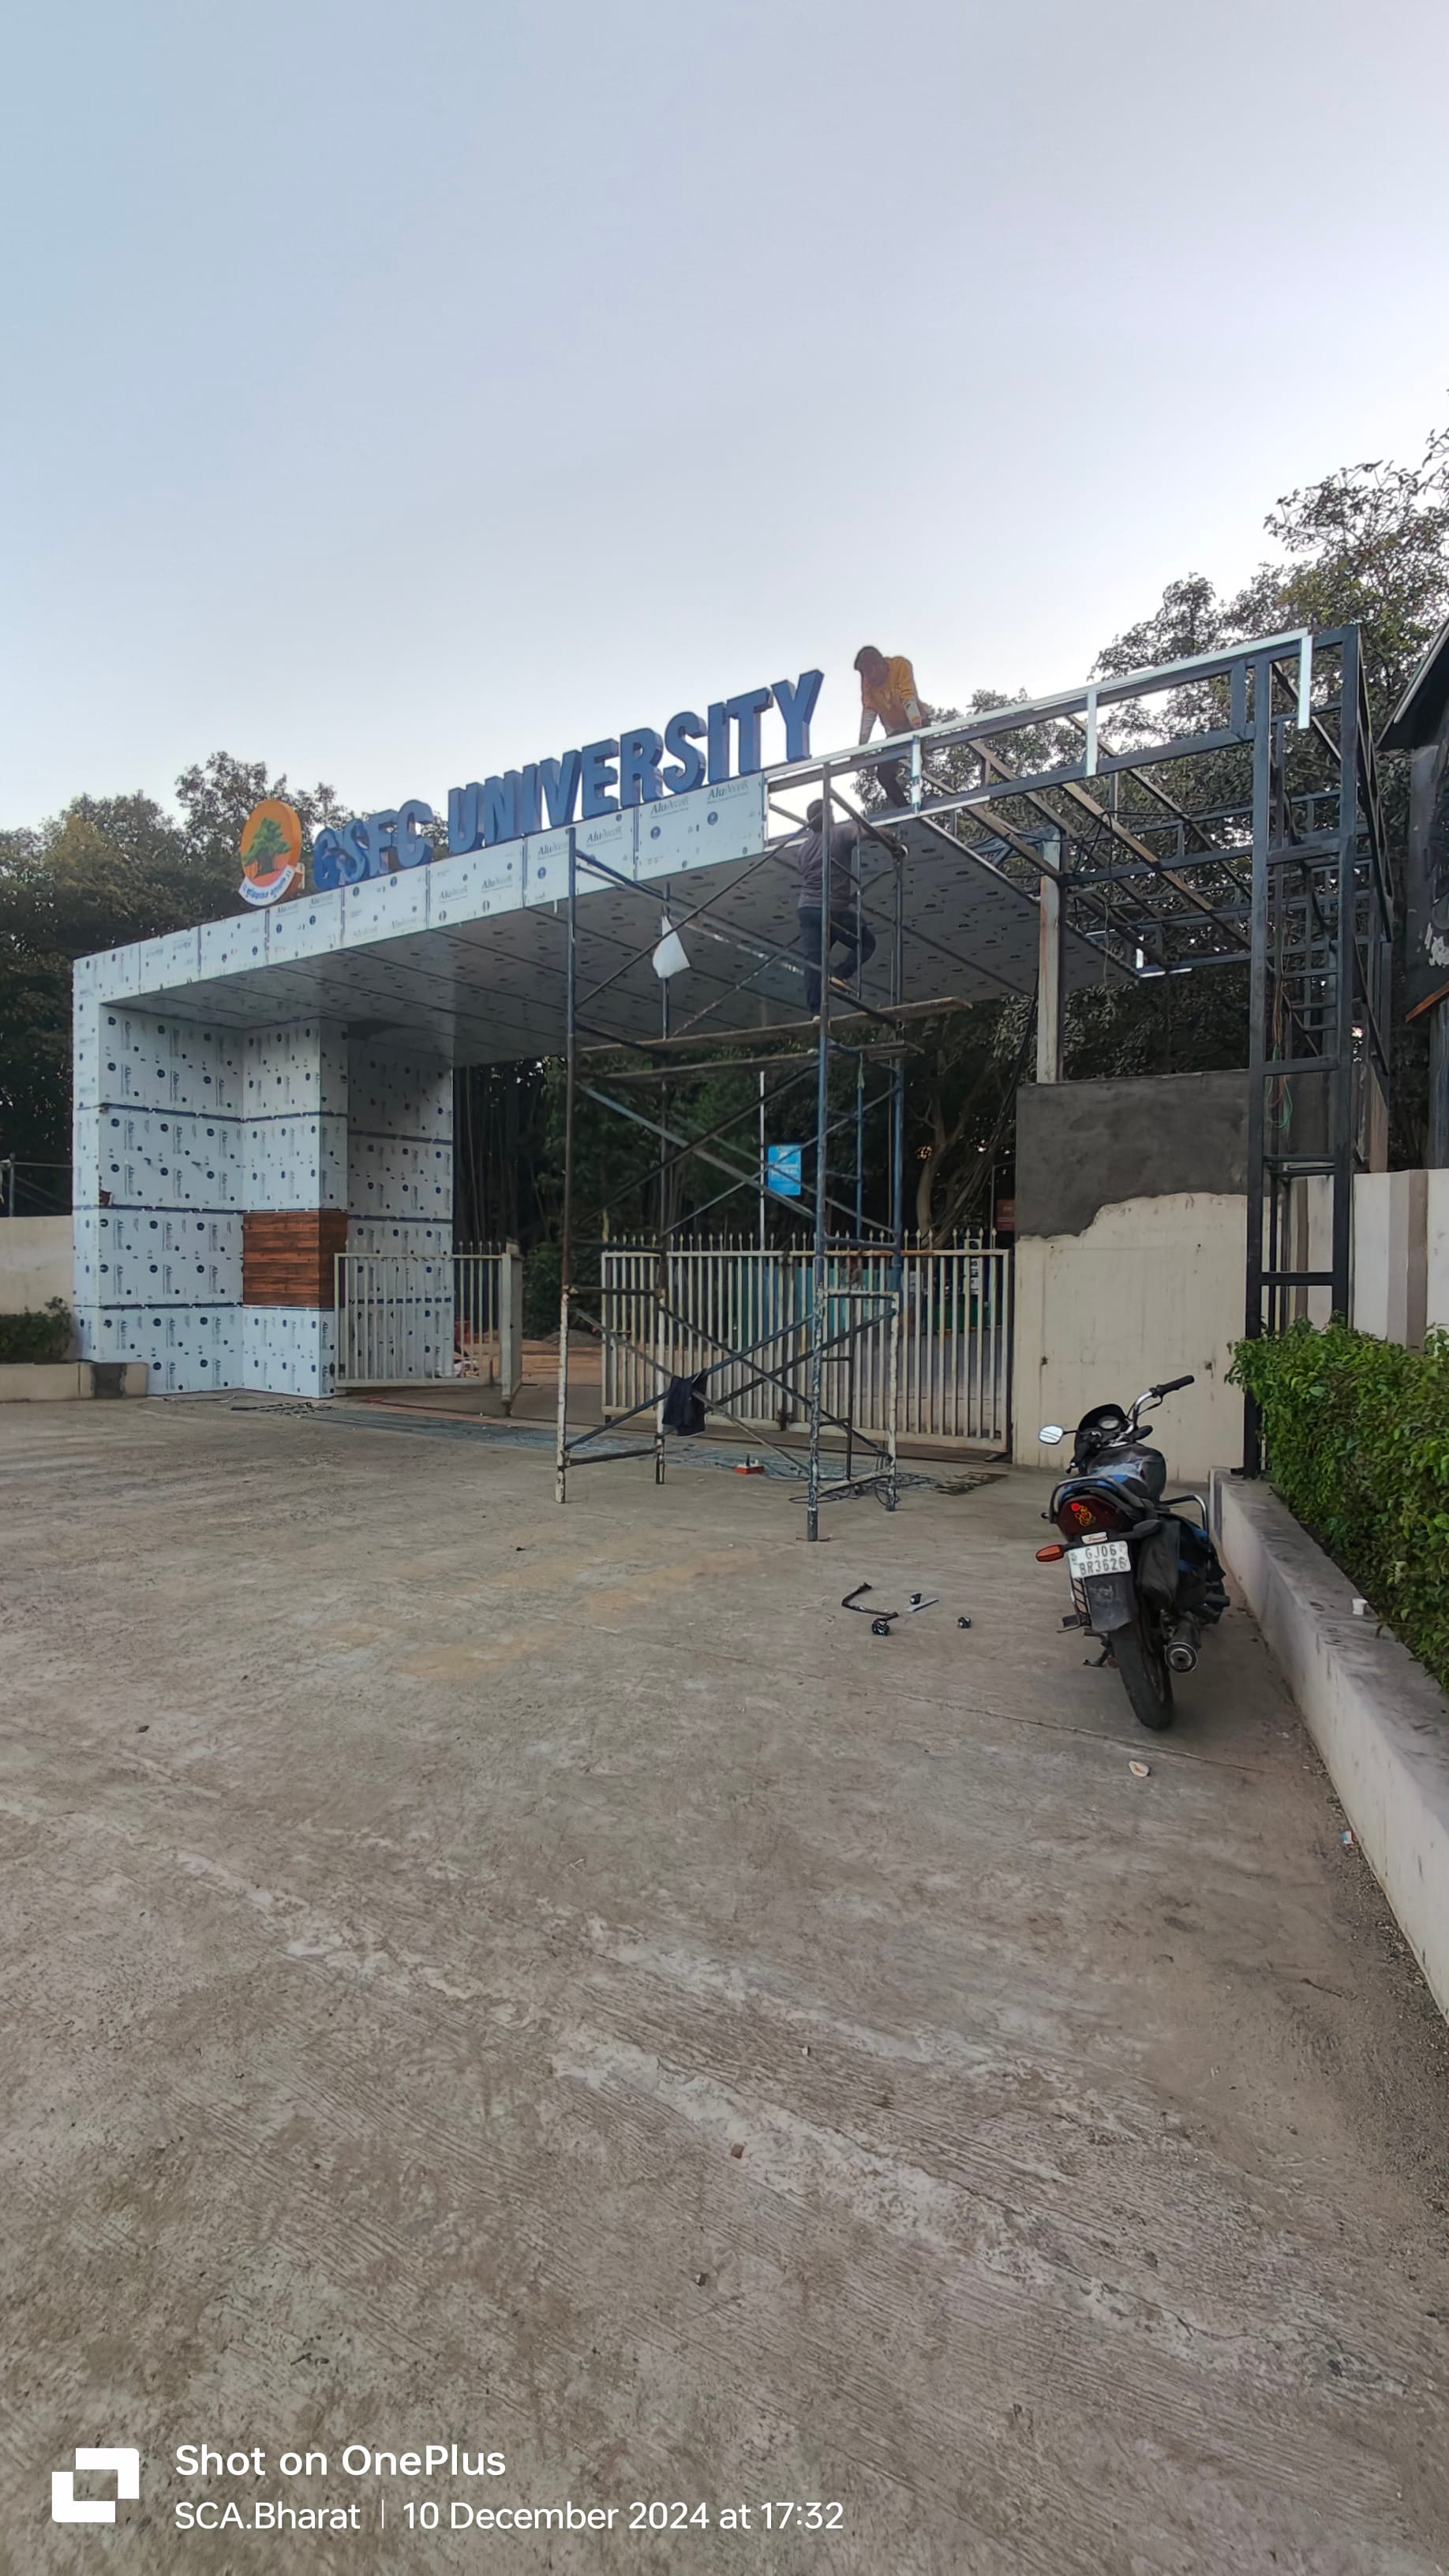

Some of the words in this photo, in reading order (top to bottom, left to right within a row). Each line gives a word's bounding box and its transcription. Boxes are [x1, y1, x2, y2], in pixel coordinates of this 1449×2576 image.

[313, 799, 433, 893] GSFC
[447, 668, 825, 856] UNIVERSITY
[1085, 1544, 1117, 1559] GJ06
